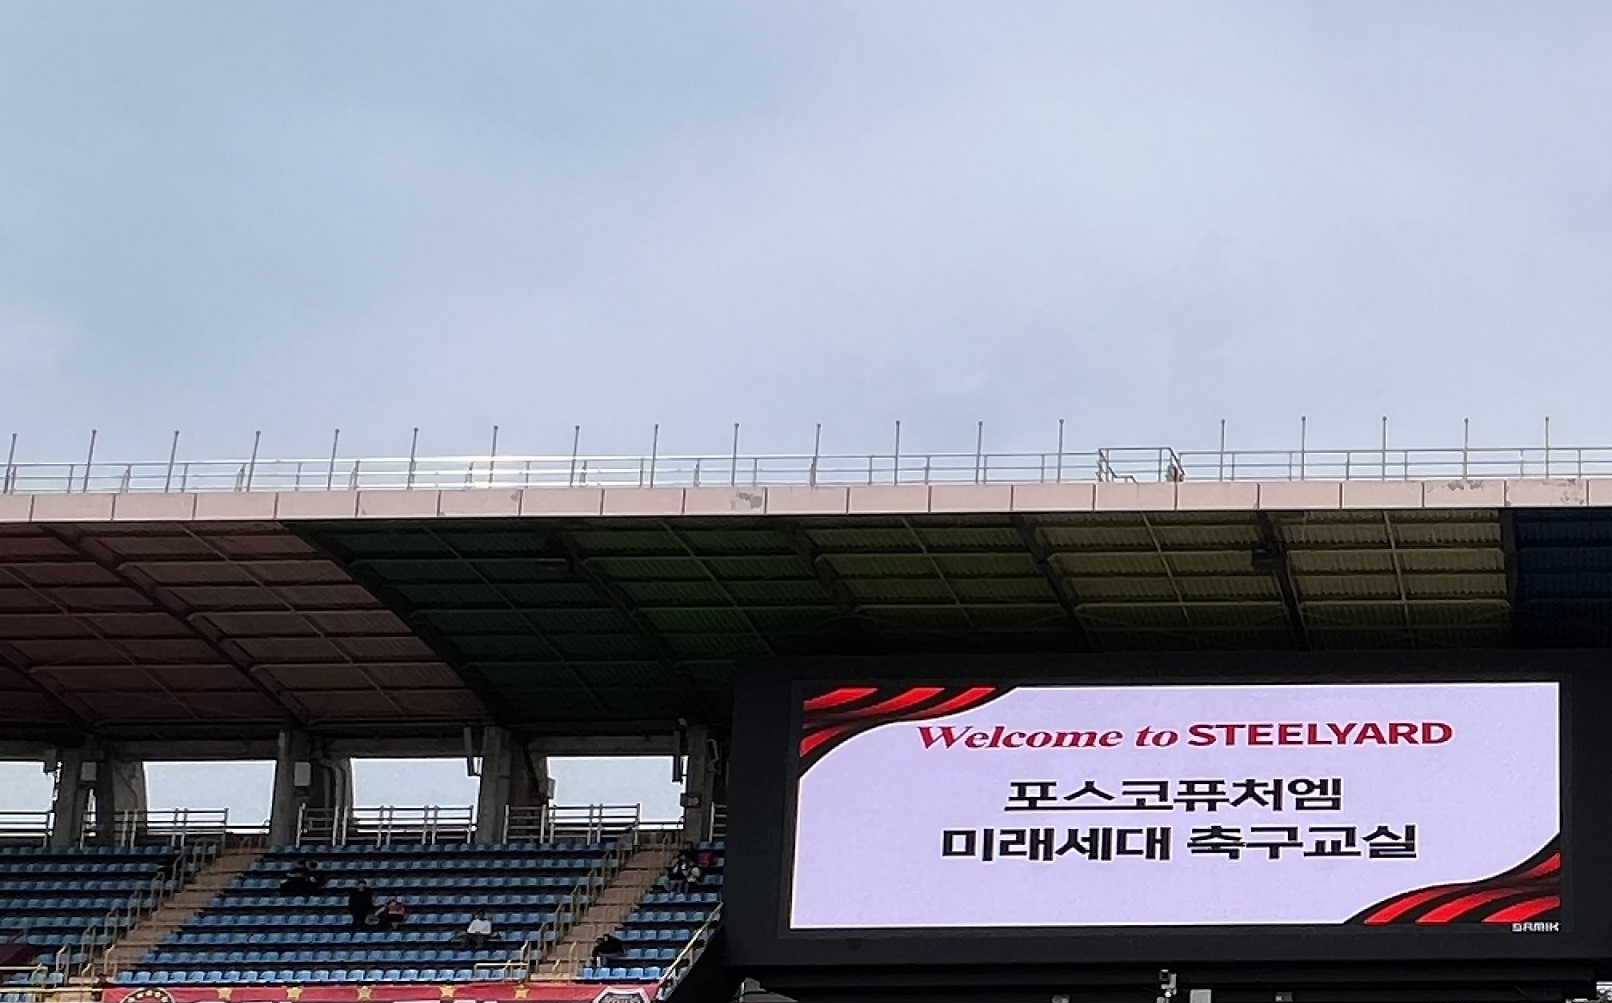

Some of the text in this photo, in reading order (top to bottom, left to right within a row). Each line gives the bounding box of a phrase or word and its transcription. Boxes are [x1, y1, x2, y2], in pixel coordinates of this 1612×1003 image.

[916, 722, 1454, 749] Welcome to STEELYARD
[1003, 778, 1344, 812] 포스코퓨처엠
[941, 824, 1417, 861] 미래세대 축구교실
